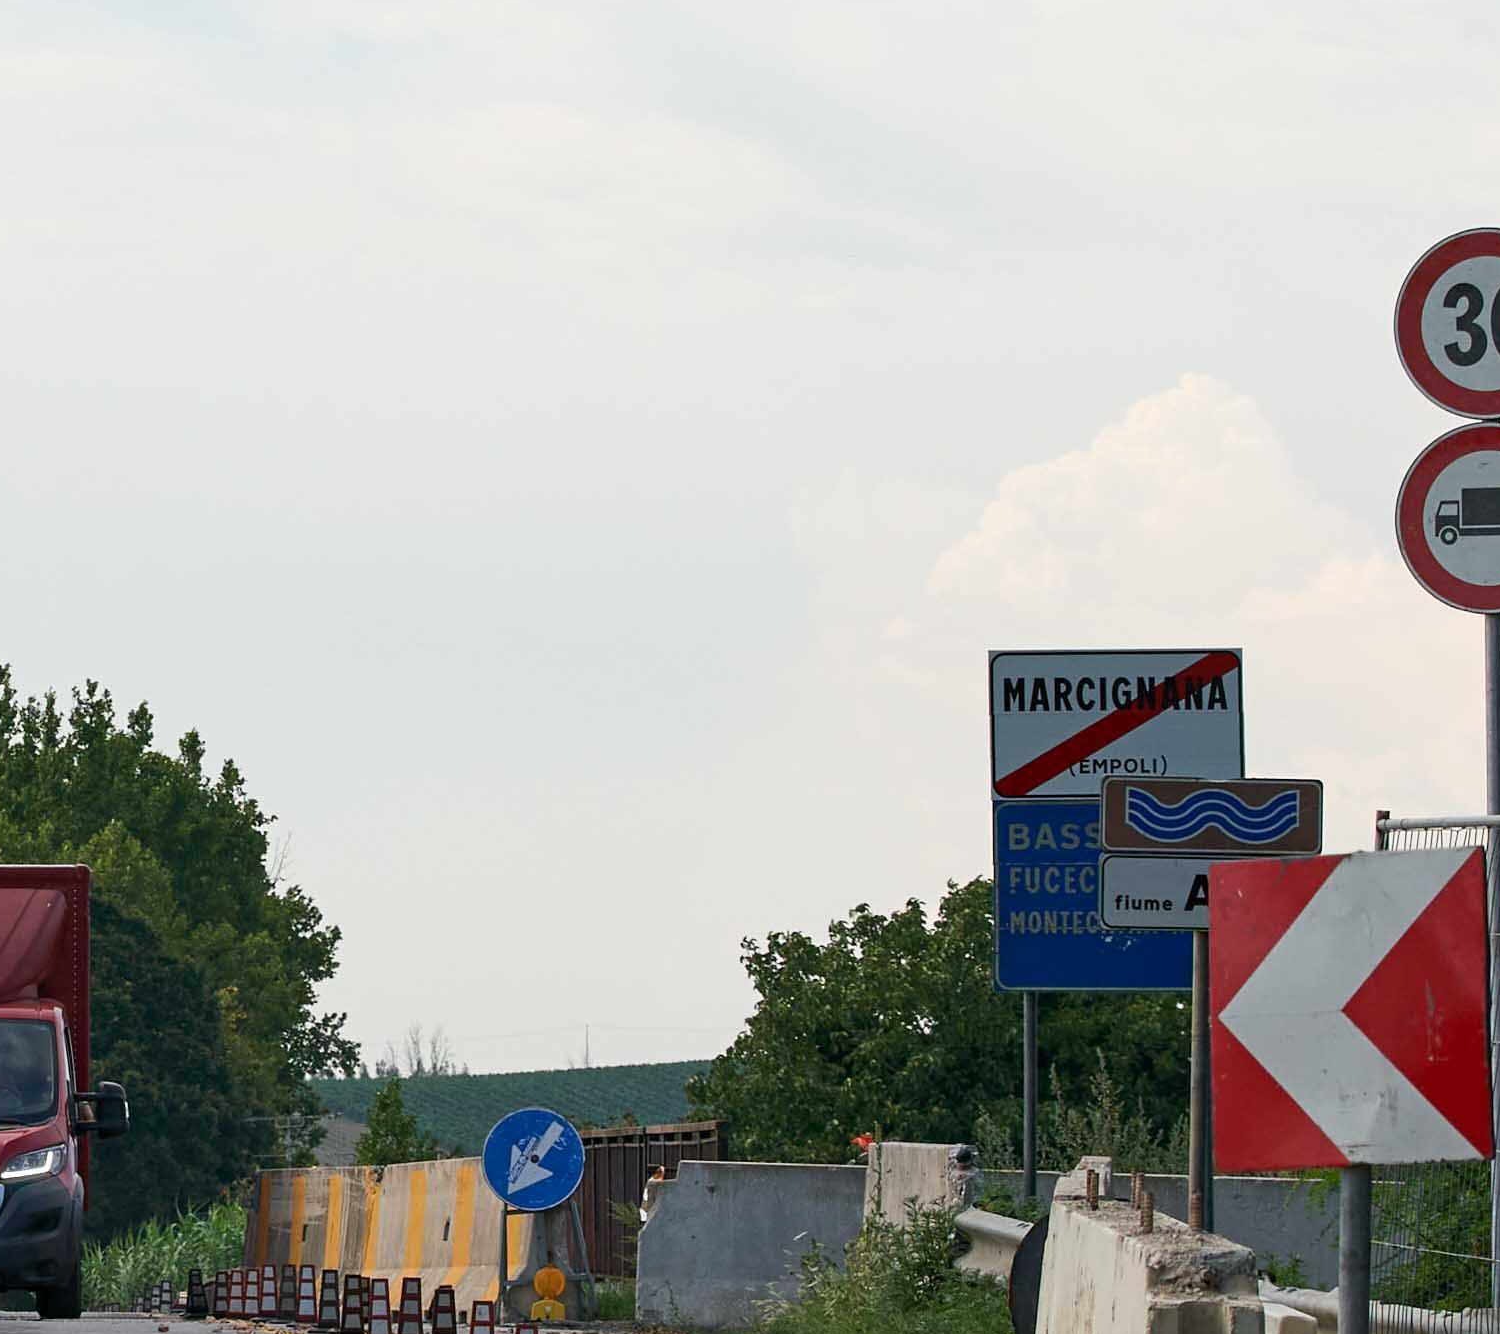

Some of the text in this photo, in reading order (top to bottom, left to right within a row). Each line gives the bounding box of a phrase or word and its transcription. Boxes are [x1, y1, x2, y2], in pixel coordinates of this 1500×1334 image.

[1003, 676, 1228, 712] MARCIGNANA
[1068, 755, 1168, 776] (EMPOLI)
[1114, 895, 1174, 911] fiume
